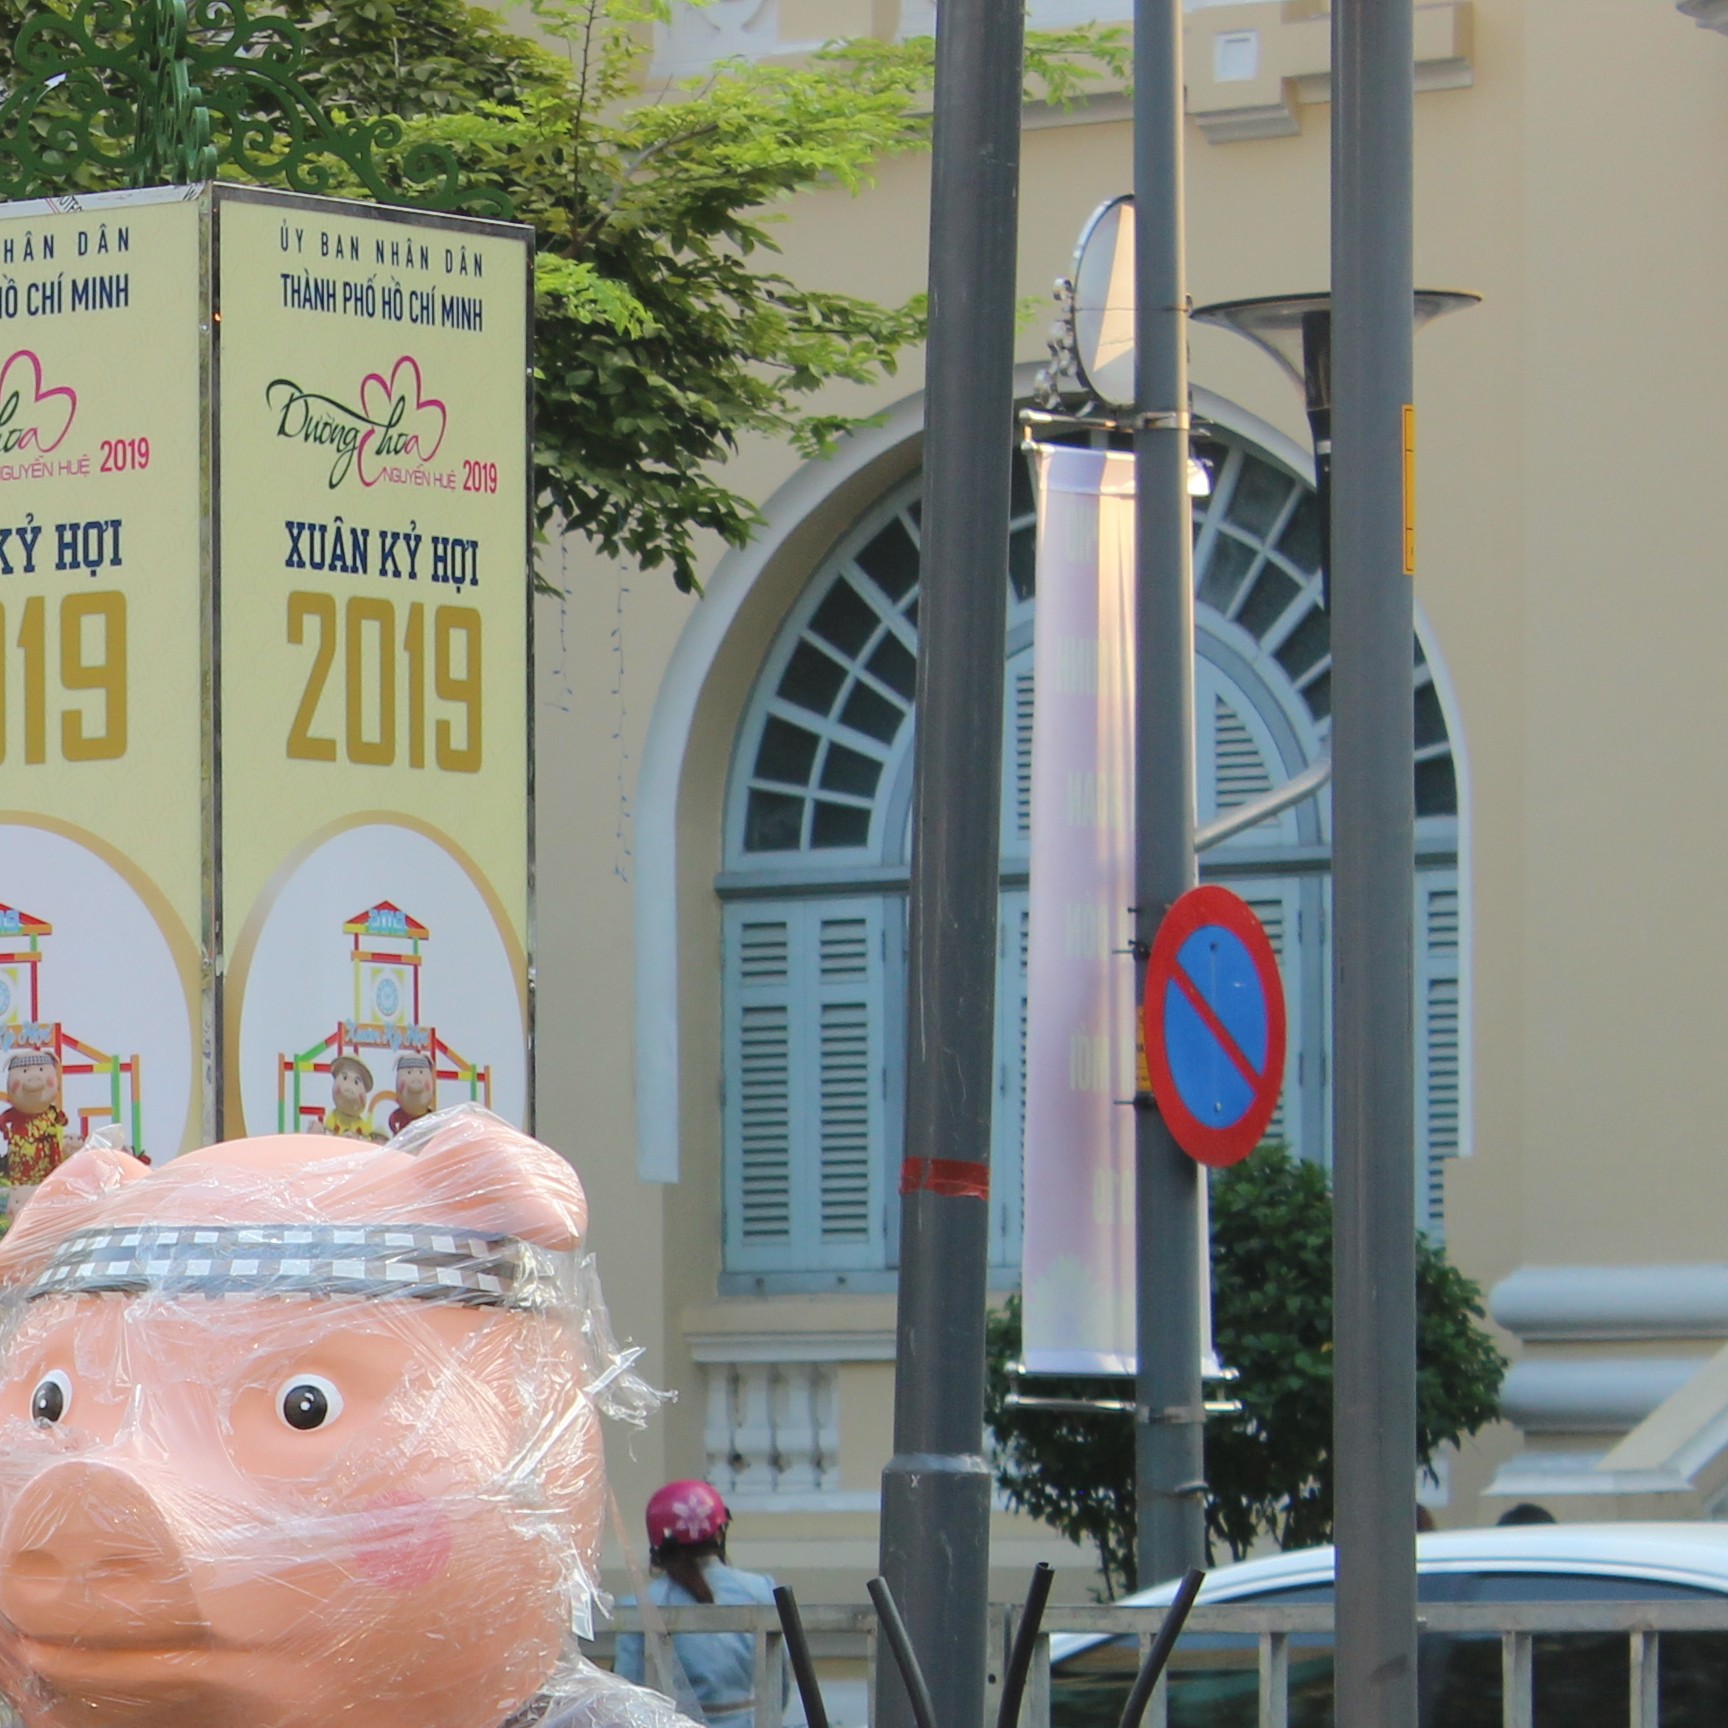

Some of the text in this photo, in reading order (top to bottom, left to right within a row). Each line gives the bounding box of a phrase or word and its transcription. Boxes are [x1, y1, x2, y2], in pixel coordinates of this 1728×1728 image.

[78, 224, 129, 256] DÂN
[280, 218, 483, 278] ỦY BAN NHÂN DÂN
[27, 272, 65, 317] CHÍ
[71, 273, 129, 312] MINH
[280, 268, 483, 332] THÀNH PHỐ HỒ CHÍ MINH
[58, 454, 90, 478] HUỆ
[99, 437, 150, 473] 2019
[463, 460, 498, 494] 2019
[55, 519, 122, 577] HỢI
[285, 516, 479, 594] XUÂN KỶ HỢI
[286, 589, 482, 774] 2019
